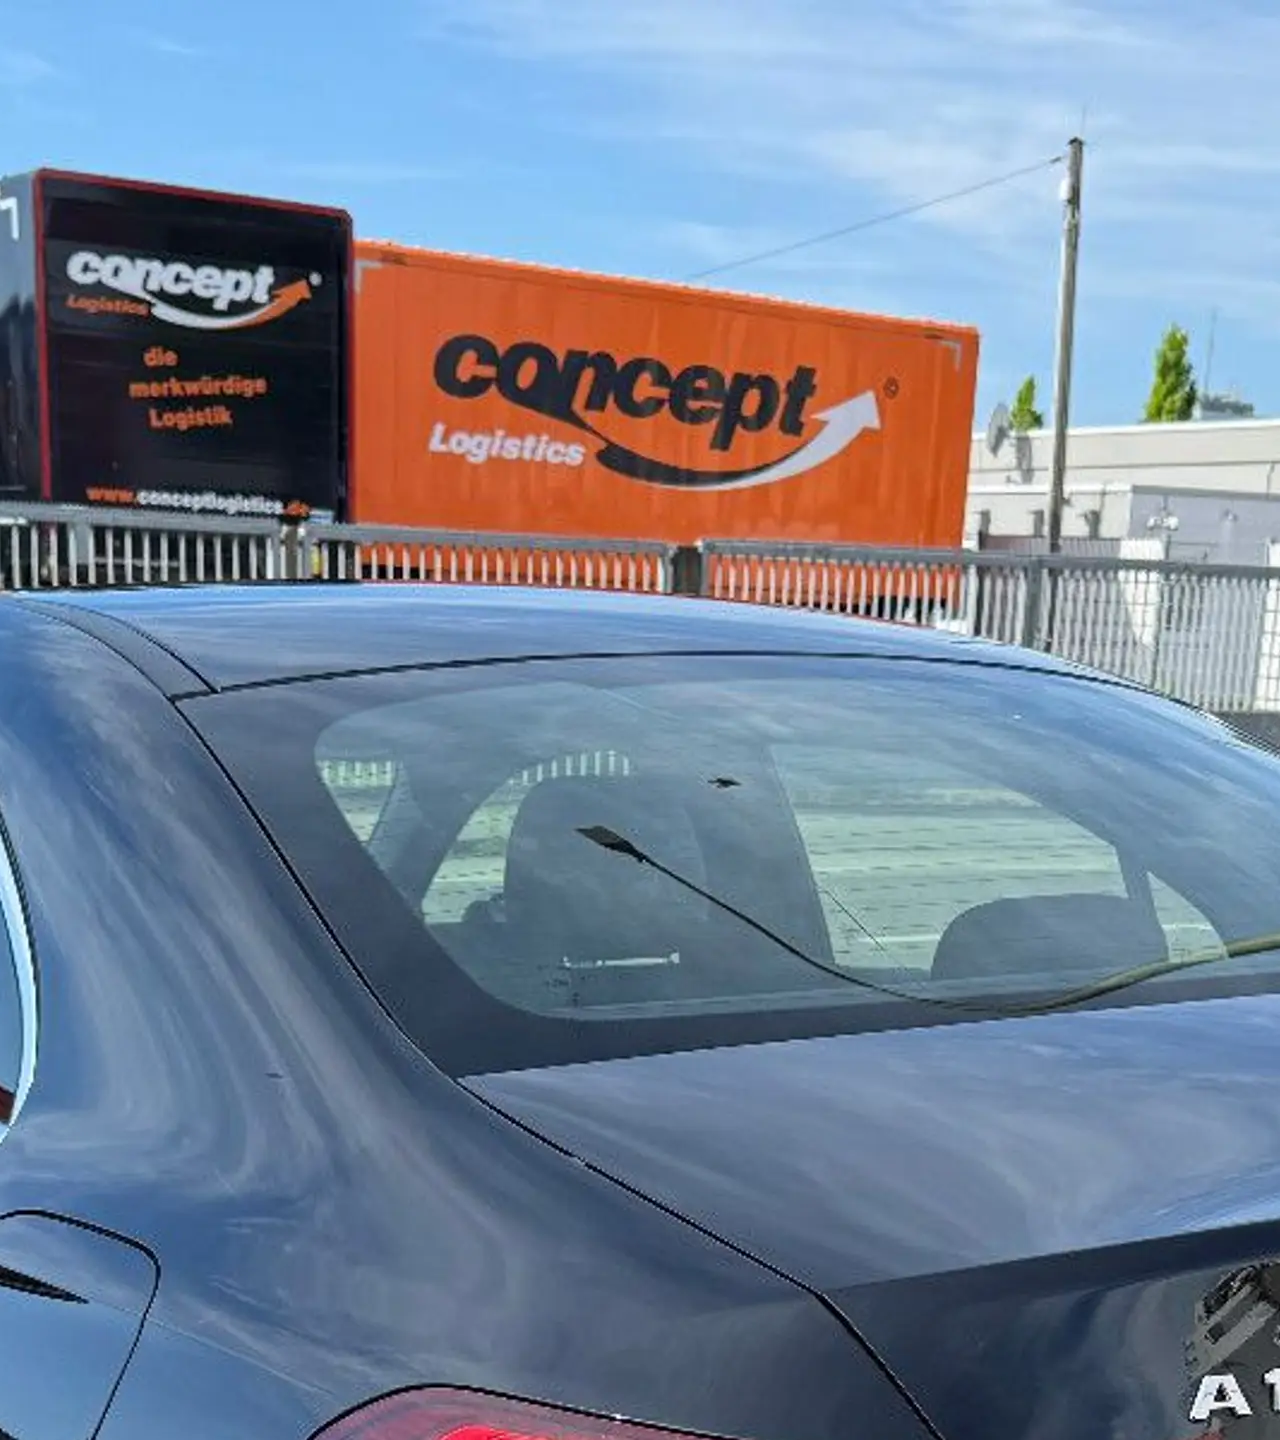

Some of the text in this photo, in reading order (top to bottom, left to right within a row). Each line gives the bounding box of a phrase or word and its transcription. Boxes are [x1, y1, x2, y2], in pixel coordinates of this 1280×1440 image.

[66, 250, 275, 311] concept
[143, 346, 179, 367] die
[433, 333, 817, 452] concept
[149, 405, 234, 430] Logistik
[428, 422, 585, 468] Logistics
[1188, 1373, 1254, 1422] A
